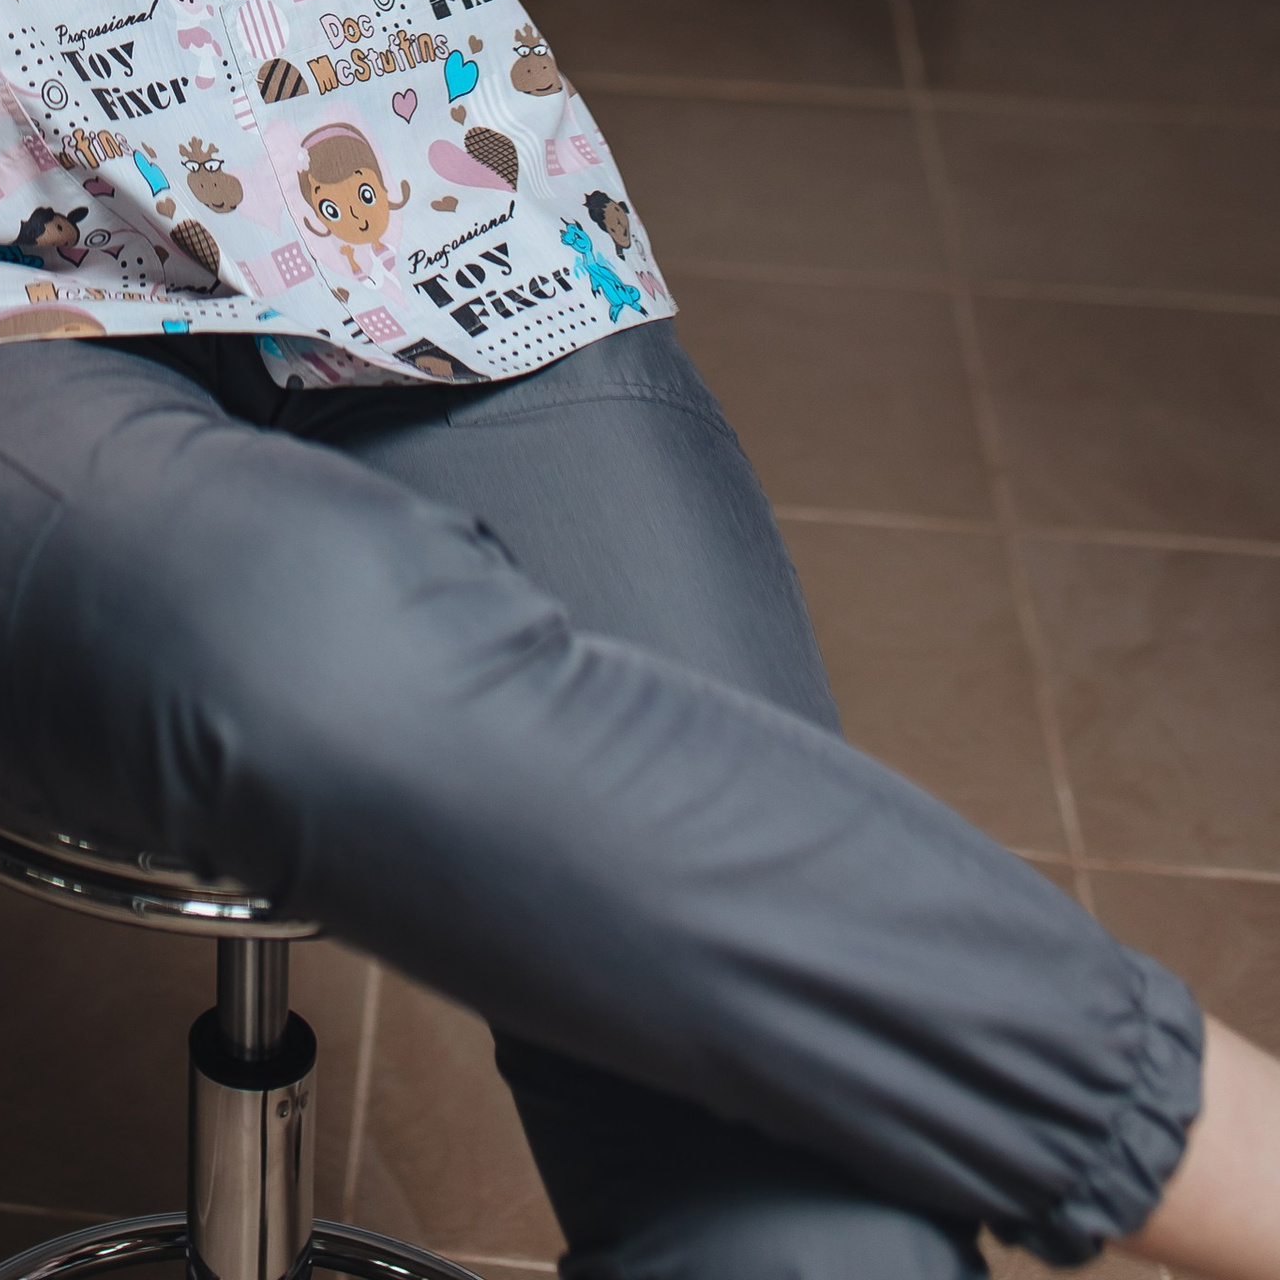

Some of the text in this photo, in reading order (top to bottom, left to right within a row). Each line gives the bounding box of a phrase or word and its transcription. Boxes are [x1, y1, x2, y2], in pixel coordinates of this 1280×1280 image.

[320, 13, 374, 49] Doc
[60, 41, 134, 82] Toy
[307, 30, 450, 95] McStuffins
[90, 76, 189, 120] Fixer
[413, 242, 512, 308] Toy
[450, 267, 572, 338] Fixer
